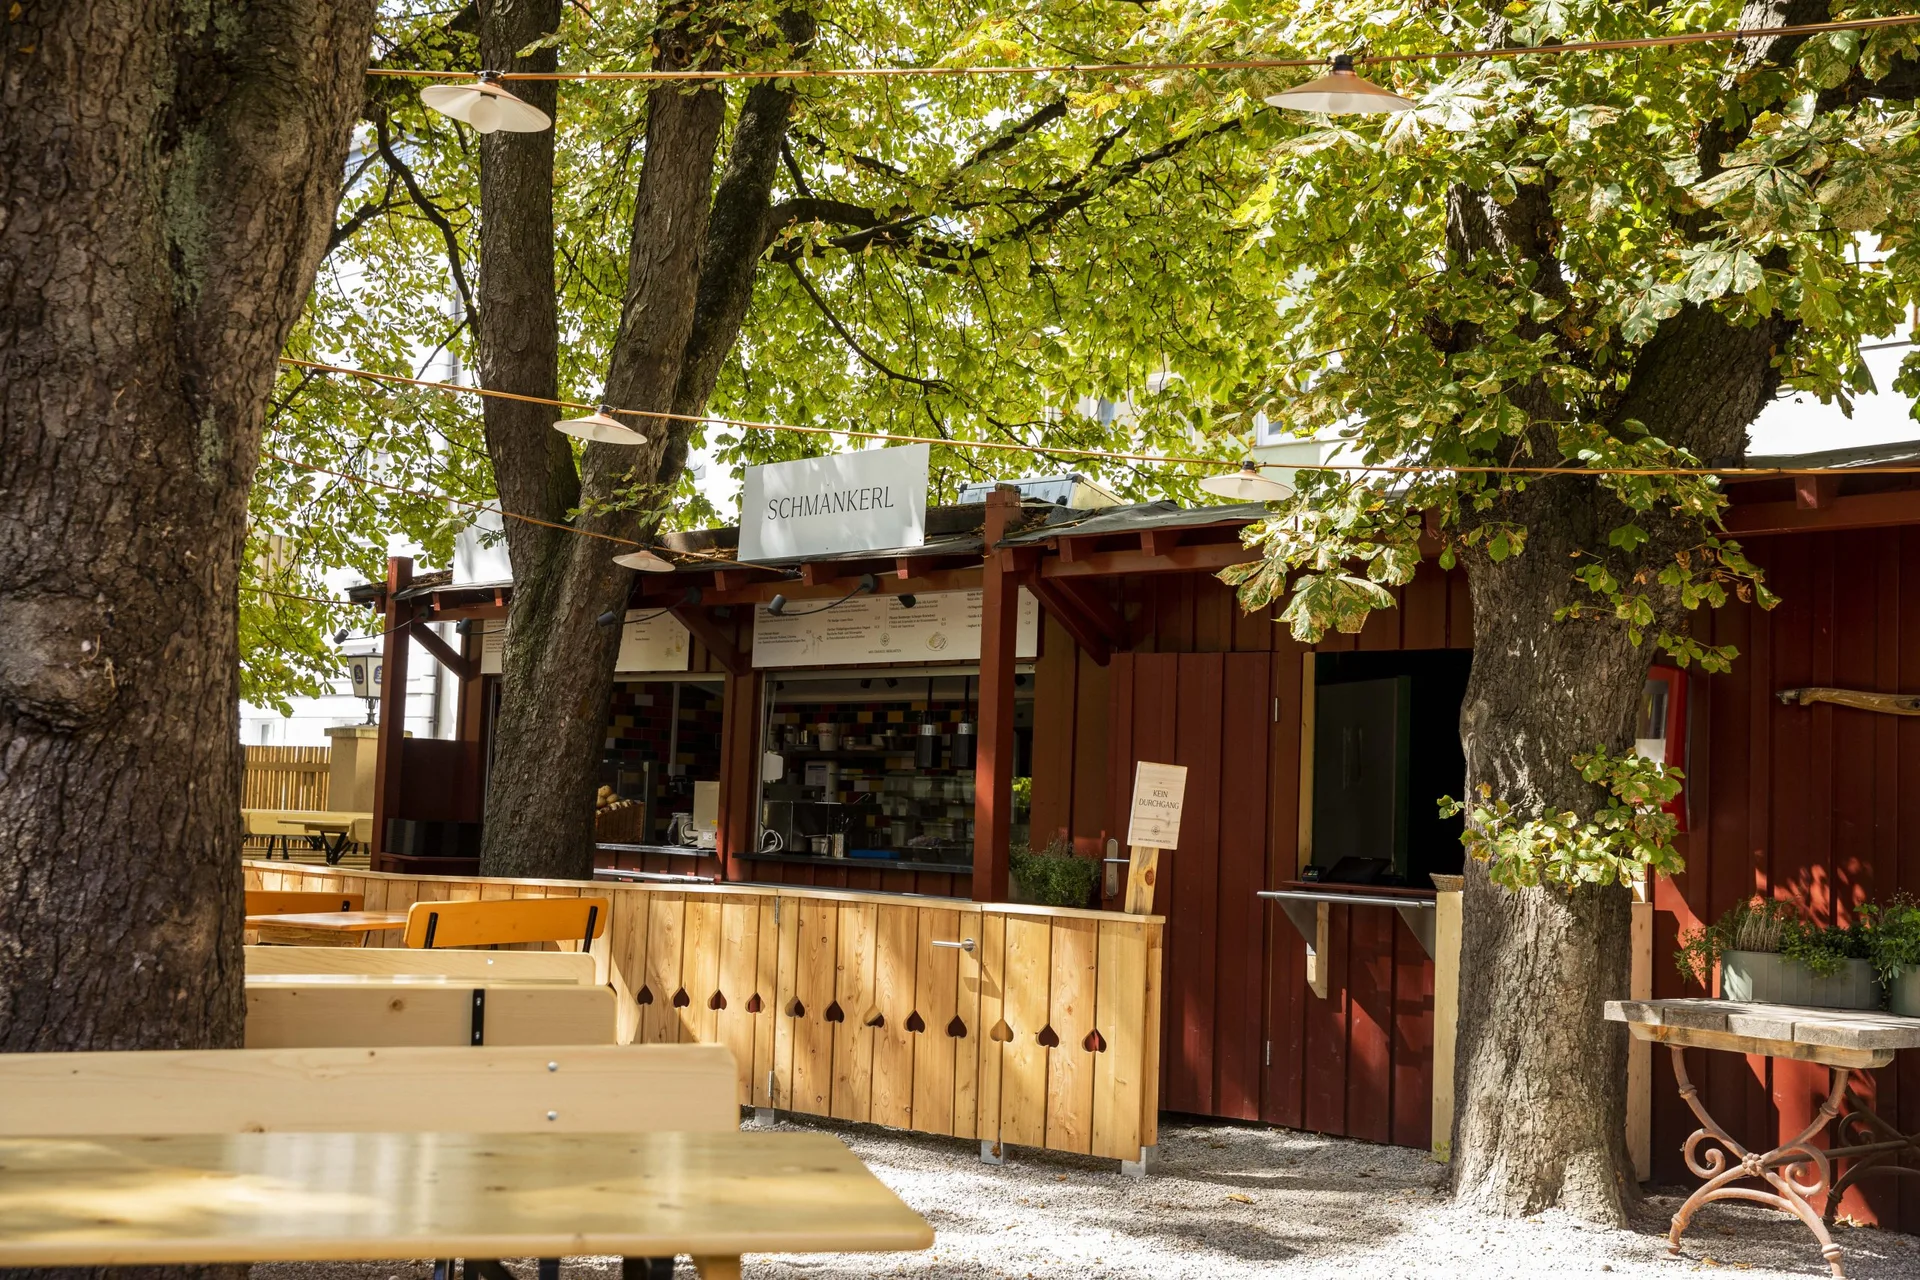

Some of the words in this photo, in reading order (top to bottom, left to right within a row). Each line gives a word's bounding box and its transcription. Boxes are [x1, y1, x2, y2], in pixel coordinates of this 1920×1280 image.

[767, 486, 894, 521] SCHMANKERL
[1152, 790, 1168, 798] KEIN
[1139, 799, 1179, 809] DURCHGANG
